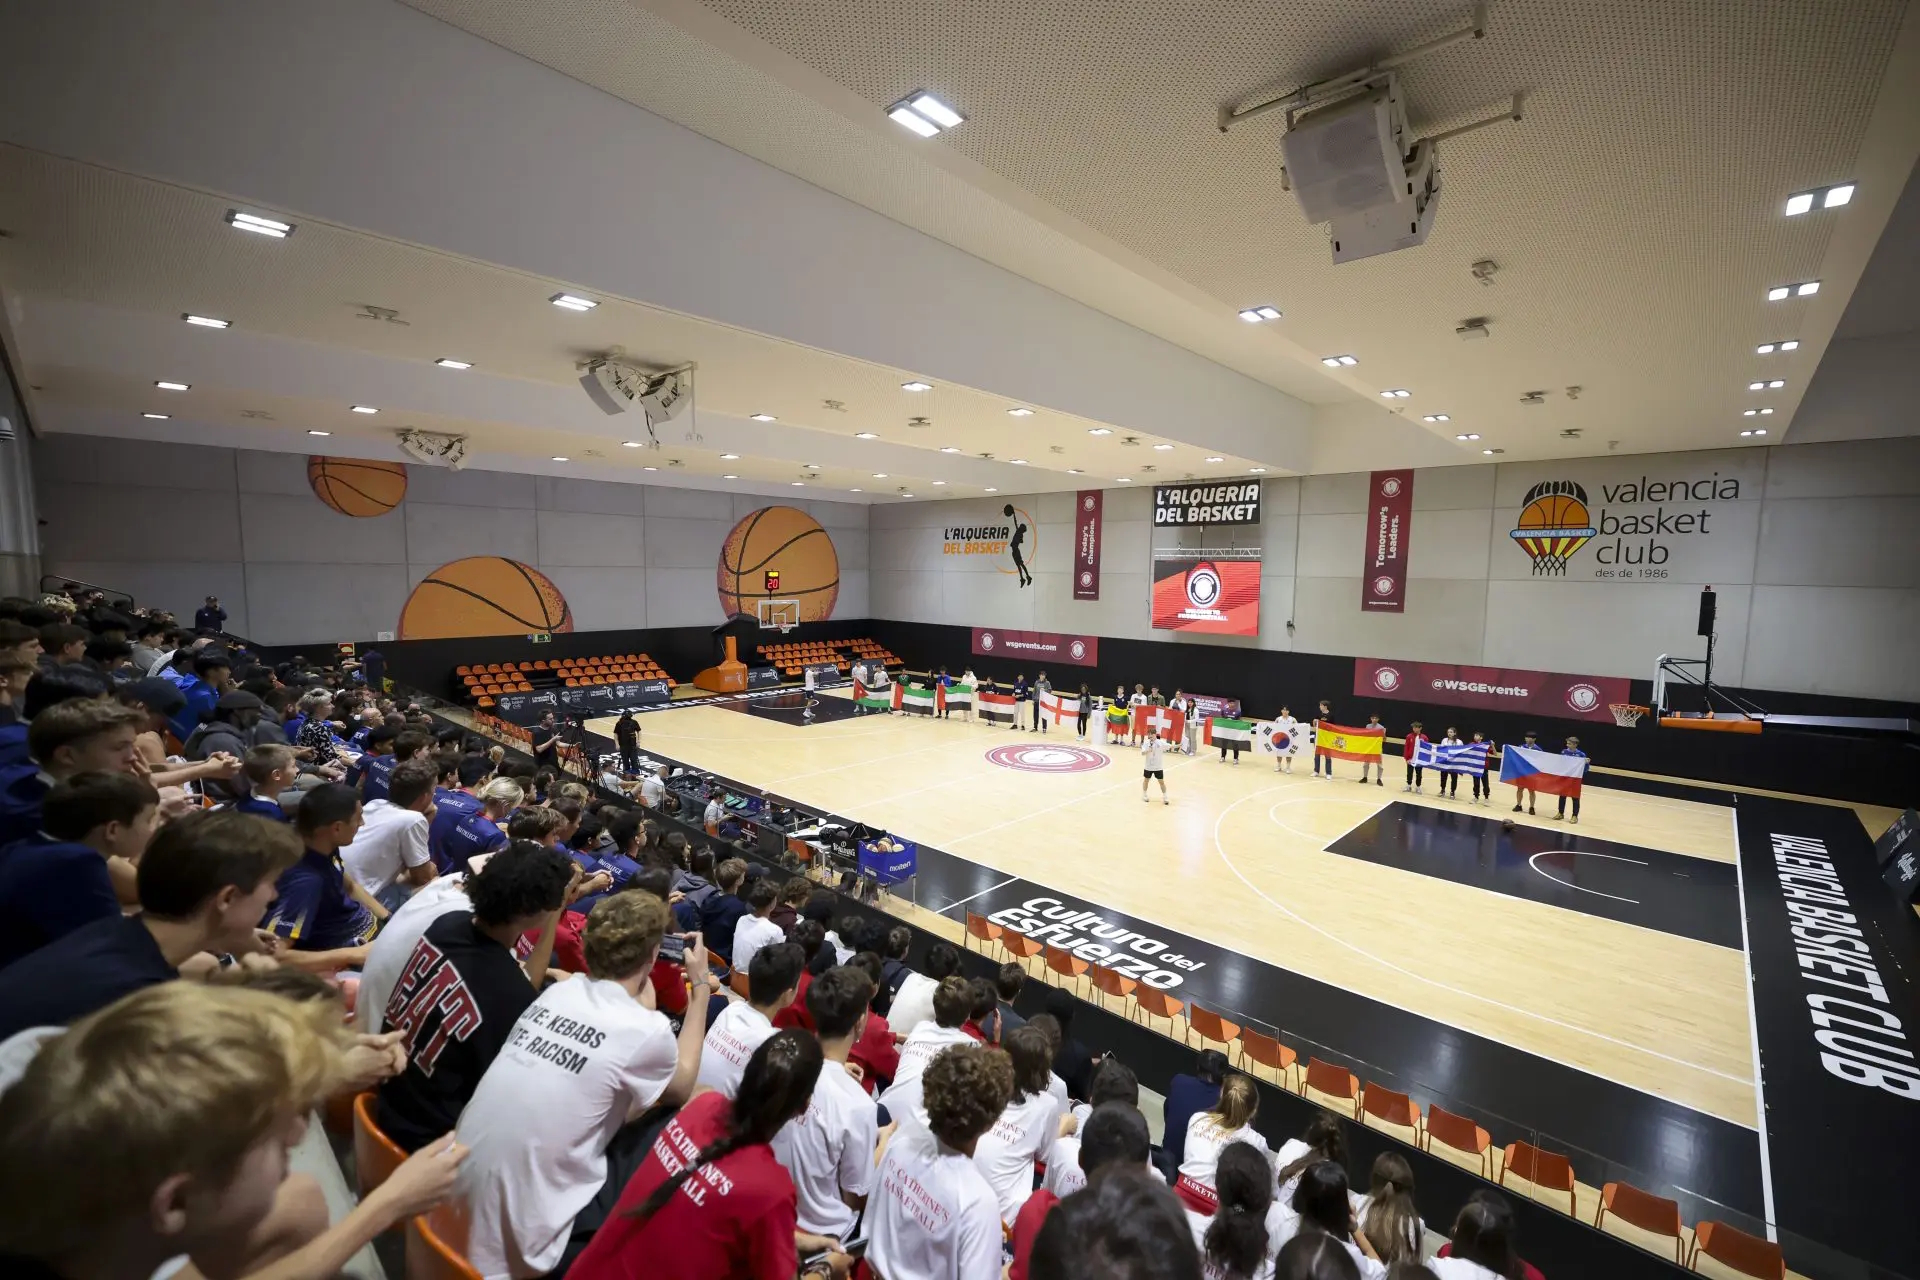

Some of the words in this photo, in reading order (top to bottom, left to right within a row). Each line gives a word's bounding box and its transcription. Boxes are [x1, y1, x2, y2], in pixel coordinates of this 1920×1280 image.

[1157, 484, 1259, 506] L'ALQUERIA
[1602, 472, 1740, 503] valencia
[1156, 507, 1184, 522] DEL
[1188, 504, 1257, 522] BASKET
[1600, 507, 1711, 535] basket
[944, 526, 1010, 541] L'ALQUERIA
[944, 543, 964, 554] DEL
[964, 542, 1008, 554] BASKET
[1376, 506, 1388, 568] Tomorrow's
[1388, 514, 1399, 559] Leaders.
[1596, 538, 1669, 564] club
[768, 578, 778, 588] 20
[1596, 568, 1614, 578] des
[1618, 568, 1632, 578] de
[1639, 569, 1668, 578] 1986
[1006, 641, 1056, 651] wsgevents.com
[1432, 678, 1528, 697] @WSGEvents
[1770, 832, 1850, 907] VALENCIA
[988, 907, 1184, 989] Esfuerzo
[1022, 897, 1169, 955] Cultura
[1158, 952, 1206, 972] del
[1786, 900, 1890, 1004] BASKET
[546, 1014, 606, 1048] KEBABS
[1806, 993, 1920, 1100] CLUB
[525, 1036, 588, 1074] RACISM
[654, 1136, 706, 1207] BASKETALL
